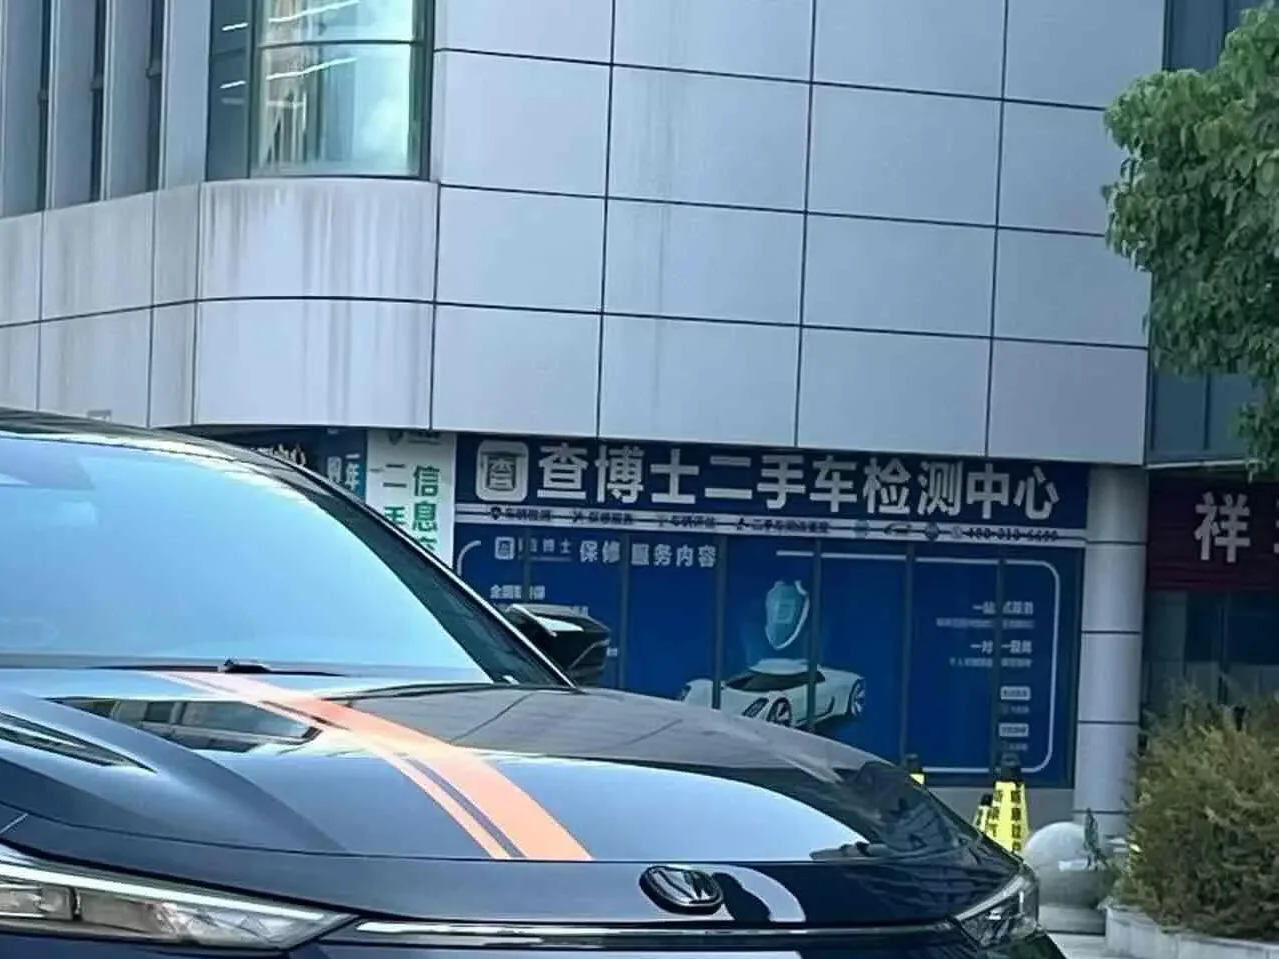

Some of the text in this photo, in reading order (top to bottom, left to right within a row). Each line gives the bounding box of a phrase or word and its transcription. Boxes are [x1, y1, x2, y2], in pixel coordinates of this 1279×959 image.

[537, 443, 1060, 521] 查博士二手车检测中心
[1194, 492, 1279, 563] 祥
